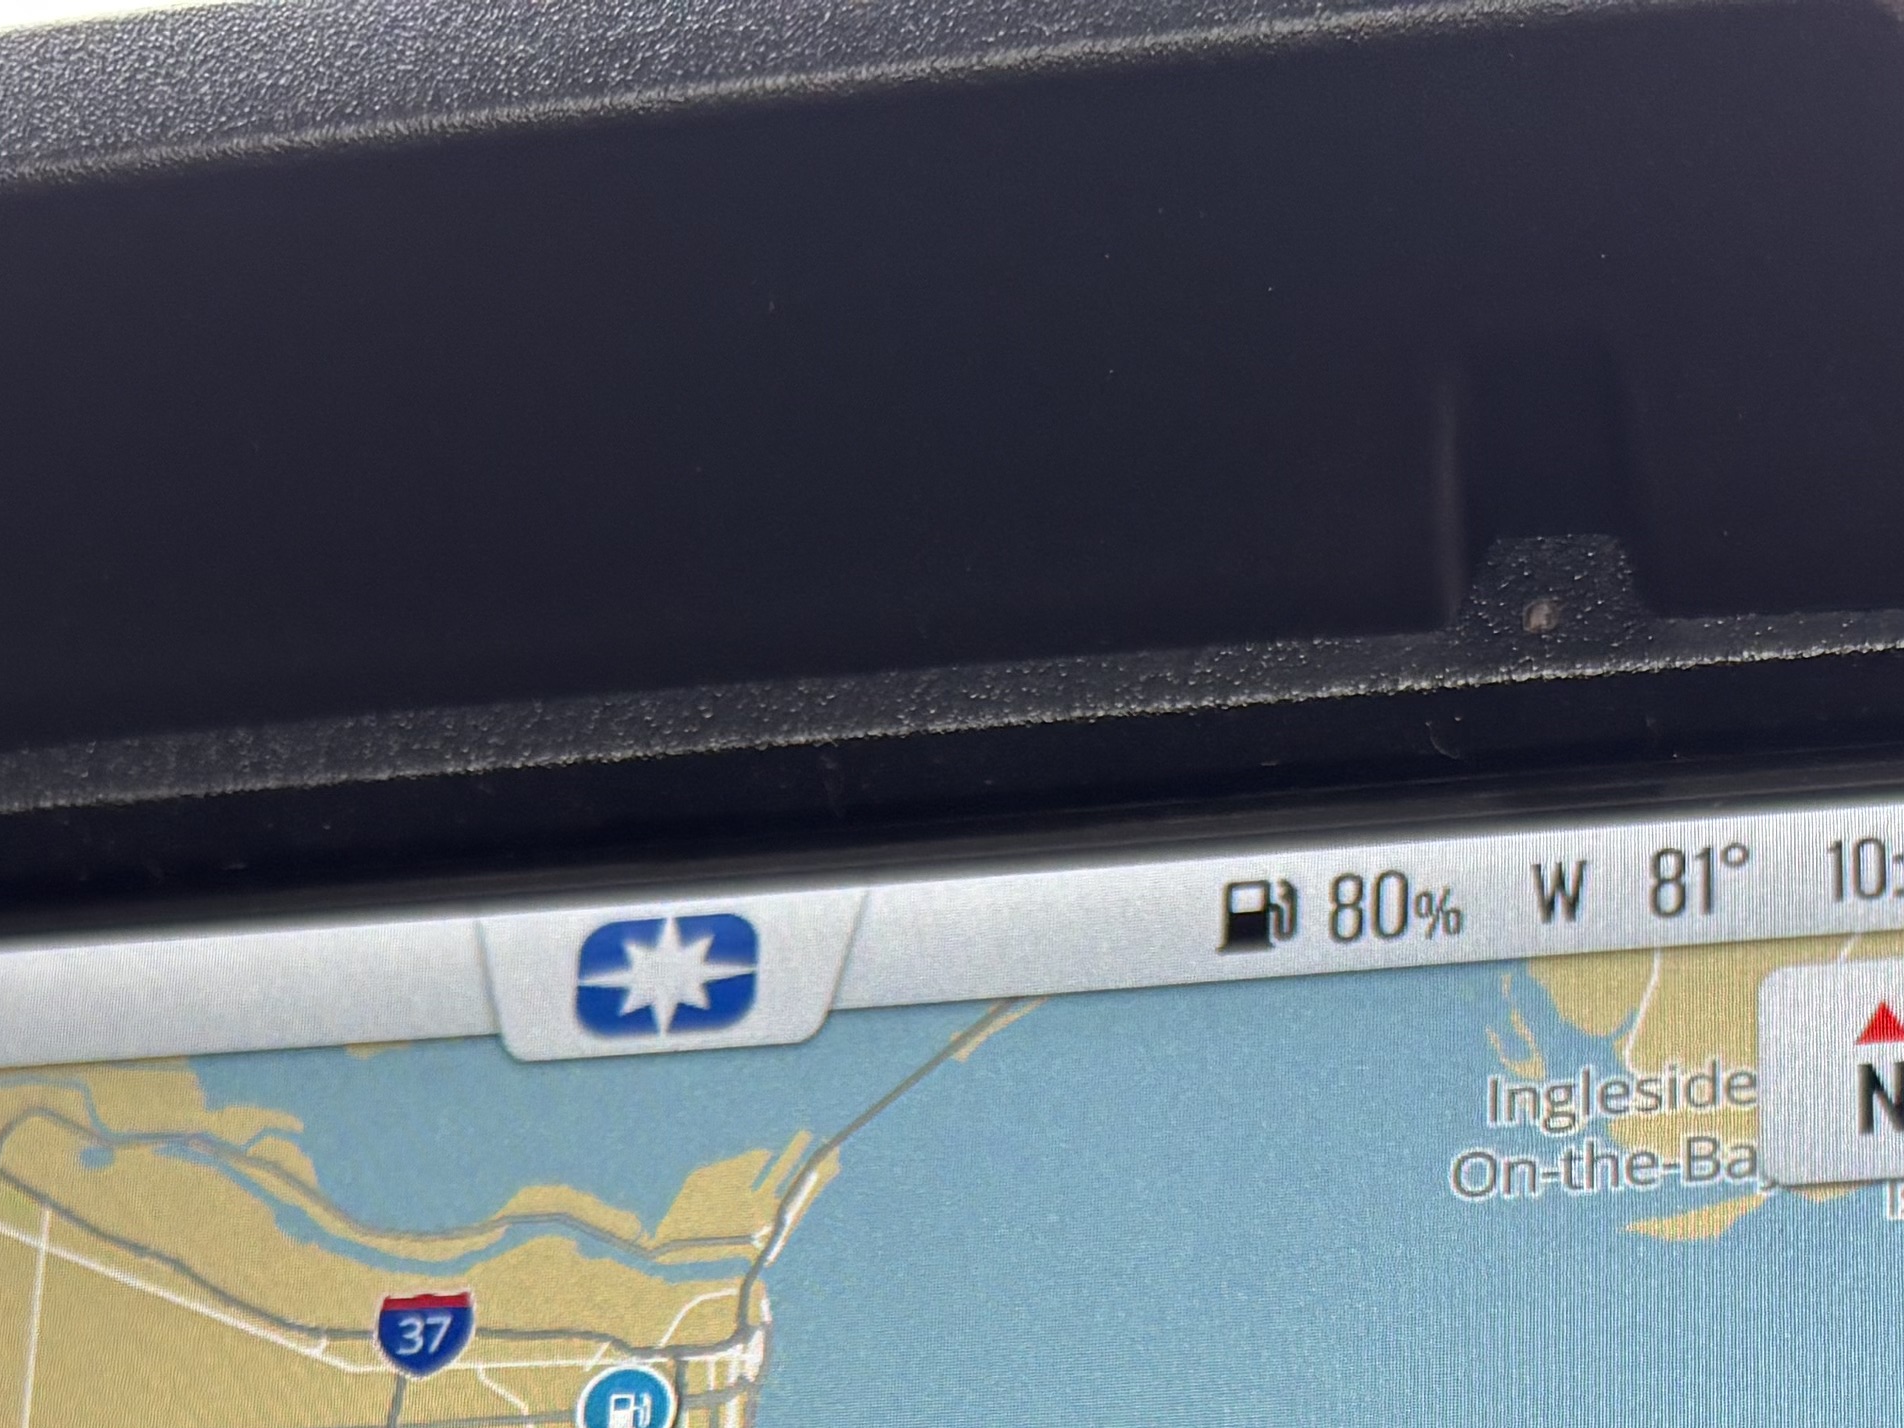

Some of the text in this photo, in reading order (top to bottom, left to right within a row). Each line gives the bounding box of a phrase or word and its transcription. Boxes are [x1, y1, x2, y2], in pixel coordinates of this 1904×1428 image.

[1329, 868, 1462, 943] 80%
[1530, 859, 1588, 926] W
[1649, 840, 1751, 919] 81°
[1488, 1055, 1759, 1135] Ingleside
[1450, 1134, 1778, 1200] On-the-Ba
[395, 1315, 453, 1356] 37
